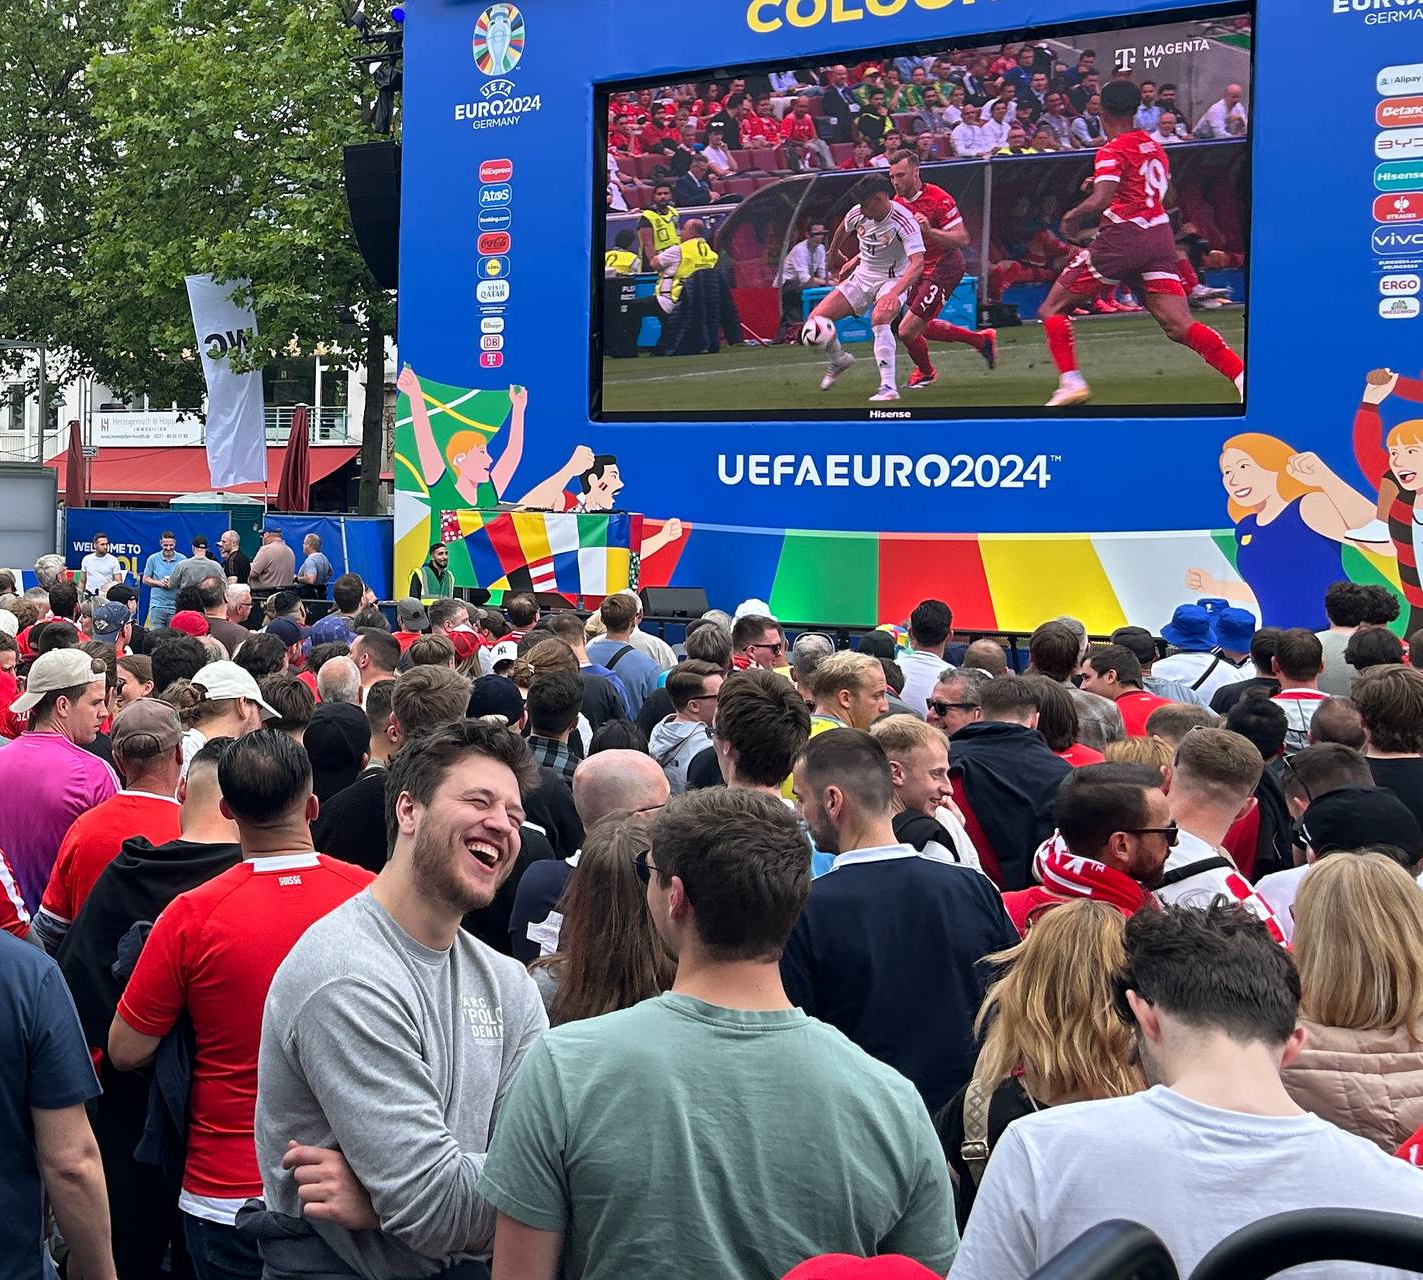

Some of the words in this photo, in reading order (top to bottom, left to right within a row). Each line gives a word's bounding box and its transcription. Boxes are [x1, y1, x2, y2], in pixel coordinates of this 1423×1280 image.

[1365, 9, 1423, 25] GERMA
[1143, 39, 1210, 57] MAGENTA
[1143, 56, 1162, 69] TV
[1394, 76, 1421, 84] Alipay
[481, 83, 512, 97] UEFA
[454, 95, 542, 120] EURO2024
[473, 116, 520, 130] GERMANY
[1139, 158, 1169, 202] 19
[1382, 280, 1418, 290] ERGO
[480, 291, 505, 299] QATAR
[486, 338, 498, 346] DB
[869, 410, 911, 419] Hisense
[126, 544, 141, 555] TO
[278, 875, 302, 887] SUISSE
